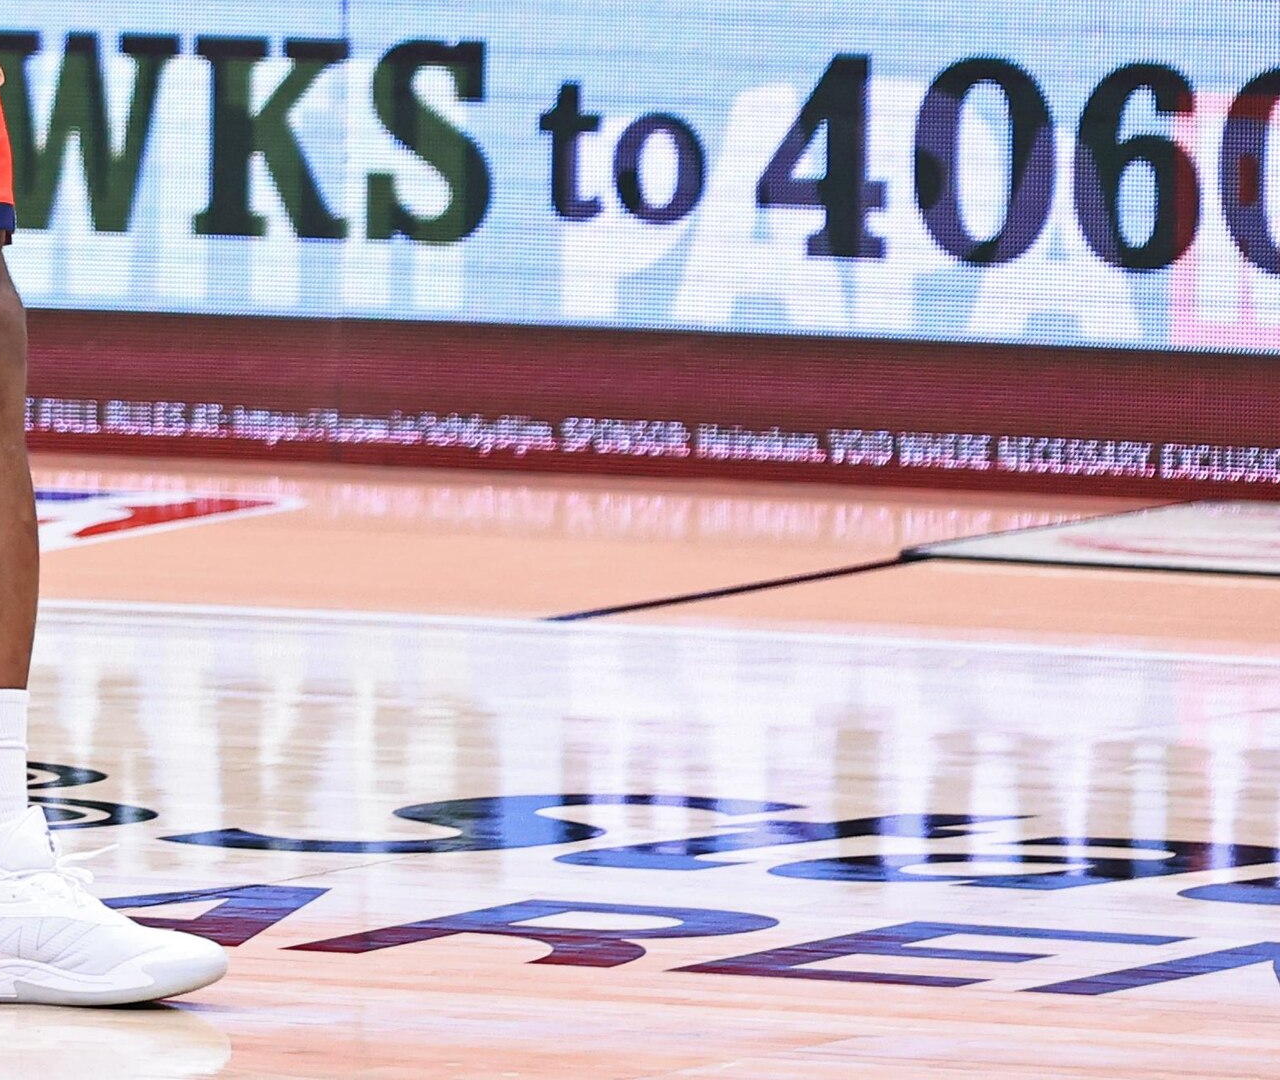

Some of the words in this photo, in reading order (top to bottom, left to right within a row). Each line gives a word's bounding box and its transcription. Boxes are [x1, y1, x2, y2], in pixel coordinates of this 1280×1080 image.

[539, 80, 705, 224] to
[39, 398, 100, 433] FULL
[104, 400, 186, 437] RULES
[828, 428, 893, 466] VOID
[896, 432, 992, 472] WHERE
